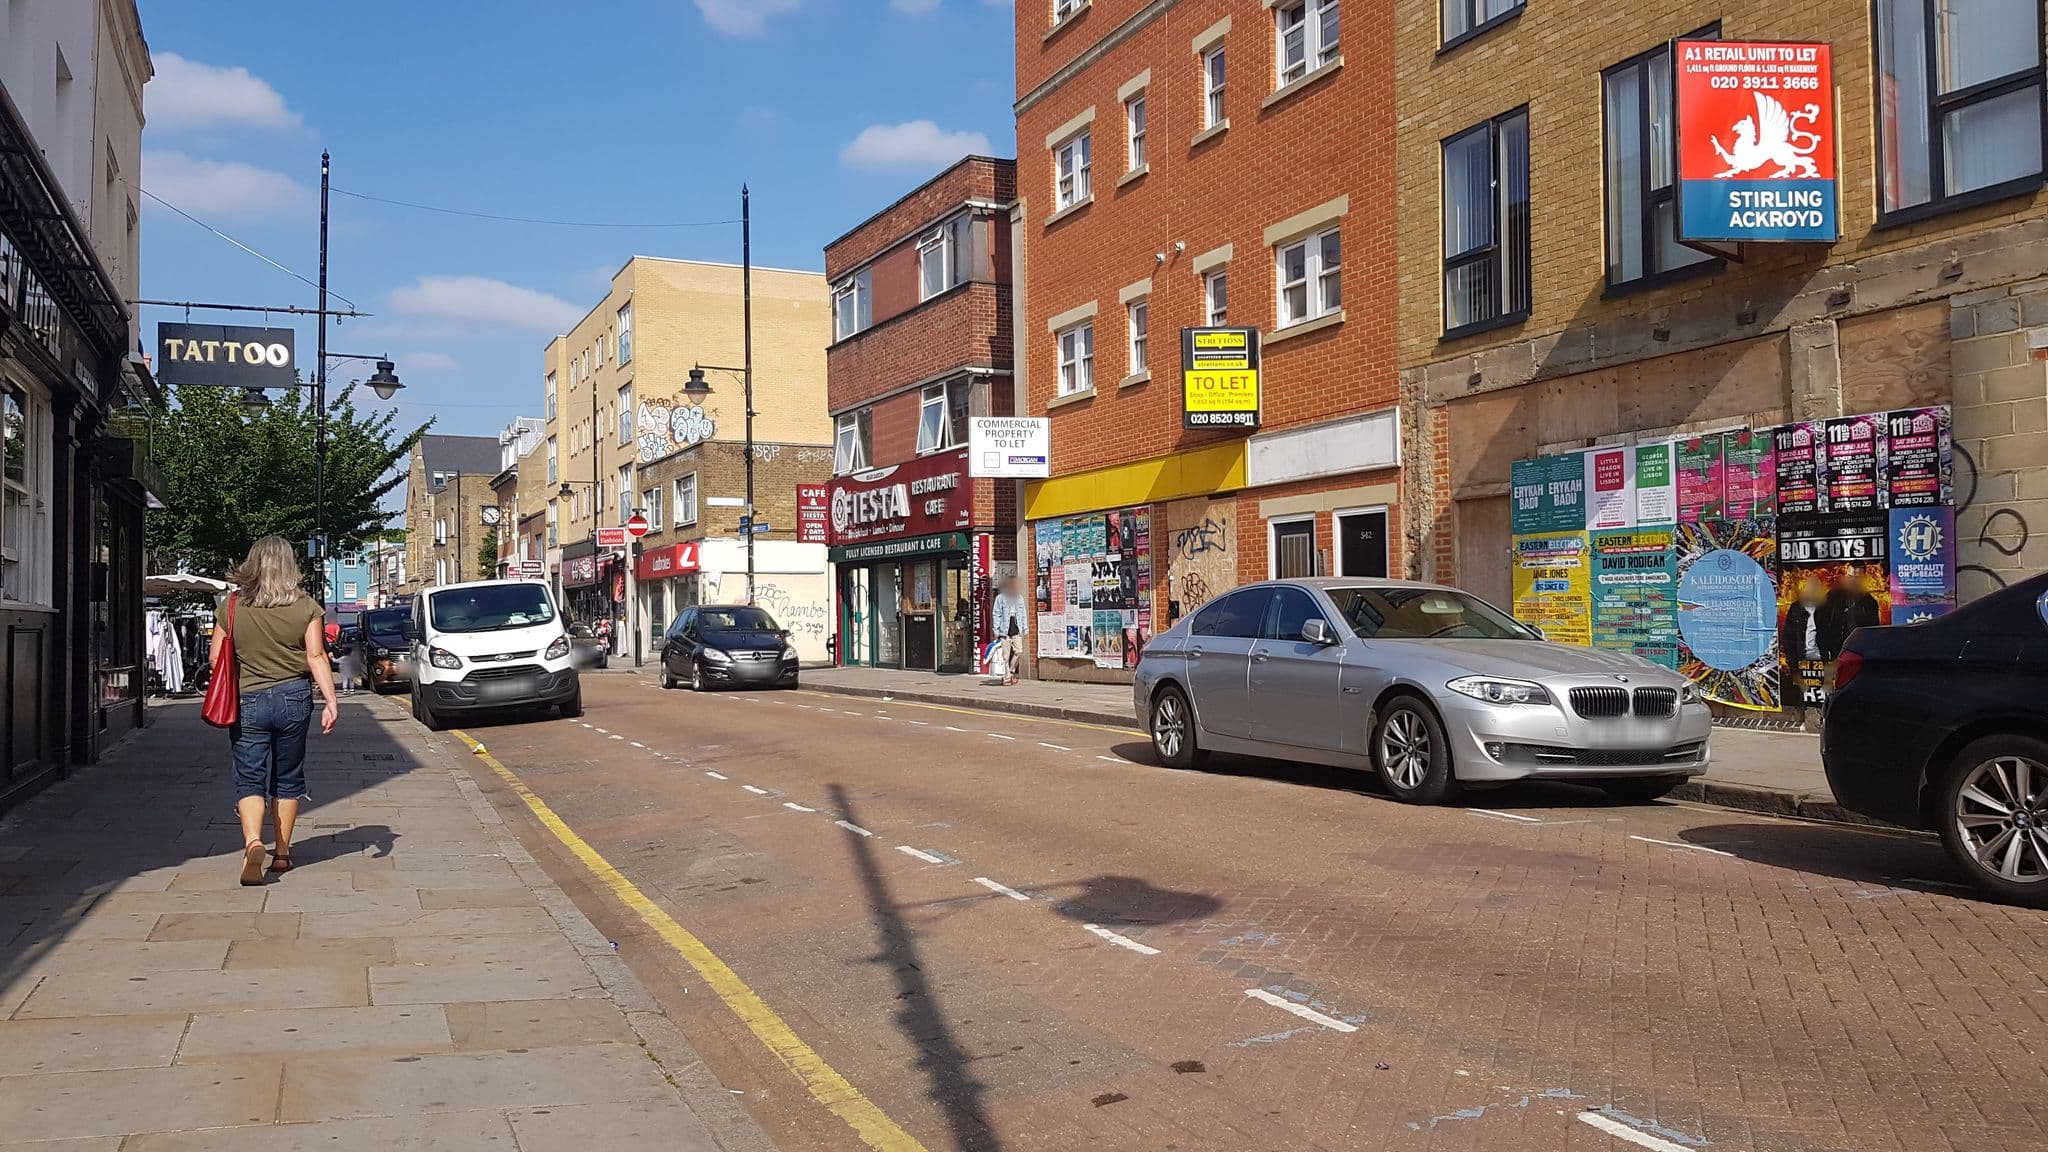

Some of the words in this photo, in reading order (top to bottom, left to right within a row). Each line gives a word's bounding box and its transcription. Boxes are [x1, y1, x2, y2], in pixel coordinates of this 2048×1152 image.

[1685, 48, 1702, 61] A1
[1705, 48, 1746, 61] RETAIL
[1747, 48, 1776, 61] UNIT
[1777, 49, 1794, 61] TO
[1797, 48, 1817, 62] LET
[1715, 65, 1738, 73] GROUND
[1738, 65, 1756, 73] FLOOR
[1790, 65, 1818, 73] BASEMENT
[1711, 76, 1738, 89] 020
[1743, 76, 1779, 89] 3911
[1783, 77, 1819, 89] 3666
[1729, 190, 1823, 208] STIRLING
[1729, 210, 1823, 228] ACKROYD
[164, 338, 290, 367] TATTOO
[1193, 376, 1215, 390] TO
[1220, 376, 1249, 390] LET
[977, 419, 1042, 429] COMMERCIAL
[1190, 413, 1209, 424] 020
[1210, 413, 1233, 424] 8520
[1234, 413, 1254, 424] 9911
[985, 430, 1035, 438] PROPERTY
[994, 440, 1007, 448] TO
[1009, 440, 1026, 448] LET
[1597, 464, 1621, 472] DRAGON
[911, 473, 960, 496] RESTAURANT
[1514, 484, 1544, 499] ERYKAH
[1548, 480, 1582, 495] ERYKAH
[802, 487, 826, 498] CAFÉ
[844, 484, 910, 526] FIESTA
[925, 498, 945, 516] CAFE
[1520, 497, 1539, 510] BADU
[1554, 493, 1577, 507] BADU
[873, 525, 886, 535] Lunch
[888, 523, 905, 534] Dinner
[1598, 536, 1632, 546] EASTERN
[1632, 533, 1669, 544] ELECTRICS
[846, 548, 859, 559] FULLY
[860, 545, 884, 557] LICENSED
[885, 540, 919, 555] RESTAURANT
[920, 540, 925, 549] &
[926, 538, 941, 549] CAFE
[1781, 542, 1811, 560] BAD
[1816, 539, 1865, 558] BOYS
[1872, 538, 1885, 556] II
[1602, 556, 1626, 569] DAVID
[1628, 555, 1666, 568] RODIGAN
[1549, 569, 1568, 578] JONES
[1691, 575, 1760, 585] KALEIDOSCOPE
[1898, 570, 1910, 578] ON
[973, 635, 981, 673] DINNER
